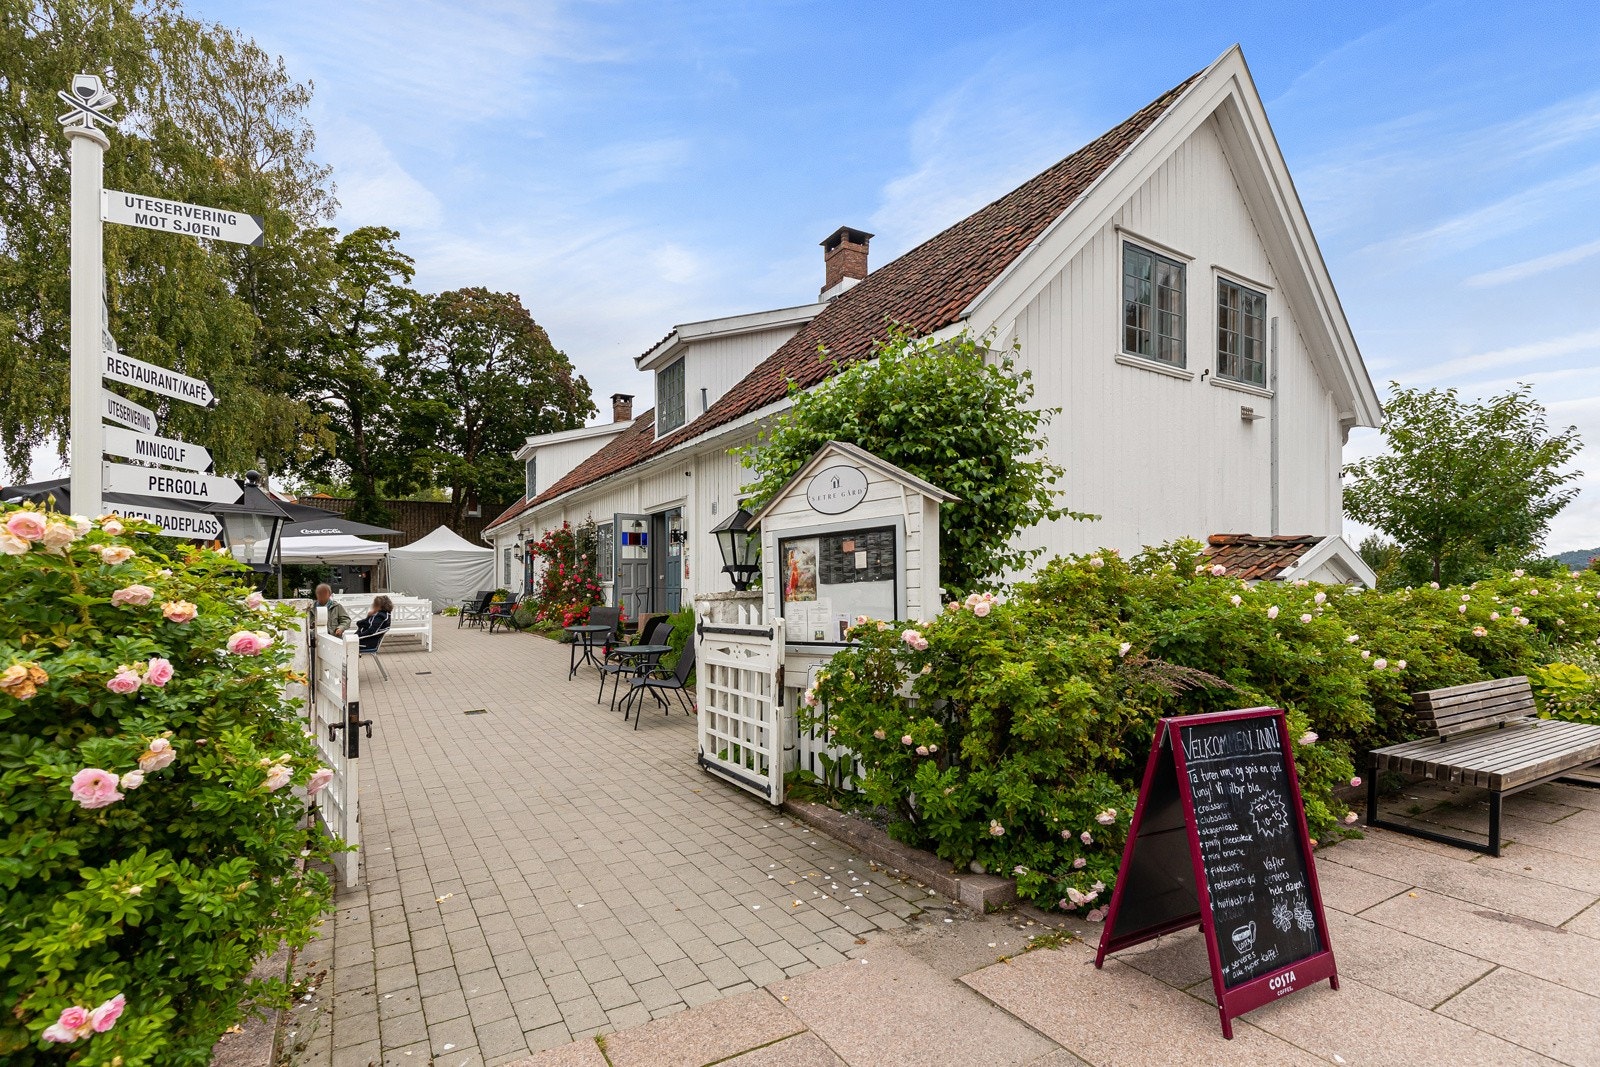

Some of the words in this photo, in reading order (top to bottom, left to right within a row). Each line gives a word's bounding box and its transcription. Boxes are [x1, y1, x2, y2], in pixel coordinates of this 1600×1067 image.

[125, 196, 237, 226] UTESERVERING
[135, 213, 168, 228] MOT
[173, 219, 221, 237] SJØEN
[107, 356, 207, 401] RESTAURANT/KAFÉ
[108, 398, 151, 431] UTESERVERING
[136, 439, 186, 463] MINIGOLF
[149, 475, 209, 497] PERGOLA
[155, 514, 218, 535] BADEPLASS
[1256, 718, 1281, 750] INN!
[1187, 768, 1199, 784] Ta
[1200, 768, 1220, 782] turen
[1235, 766, 1245, 782] og
[1245, 763, 1259, 779] spis
[1260, 765, 1269, 774] en
[1270, 762, 1282, 781] god
[1215, 781, 1224, 795] Vi
[1247, 782, 1262, 794] bla
[1255, 803, 1270, 813] Fra
[1261, 810, 1282, 827] 10-15
[1269, 970, 1297, 990] COSTA
